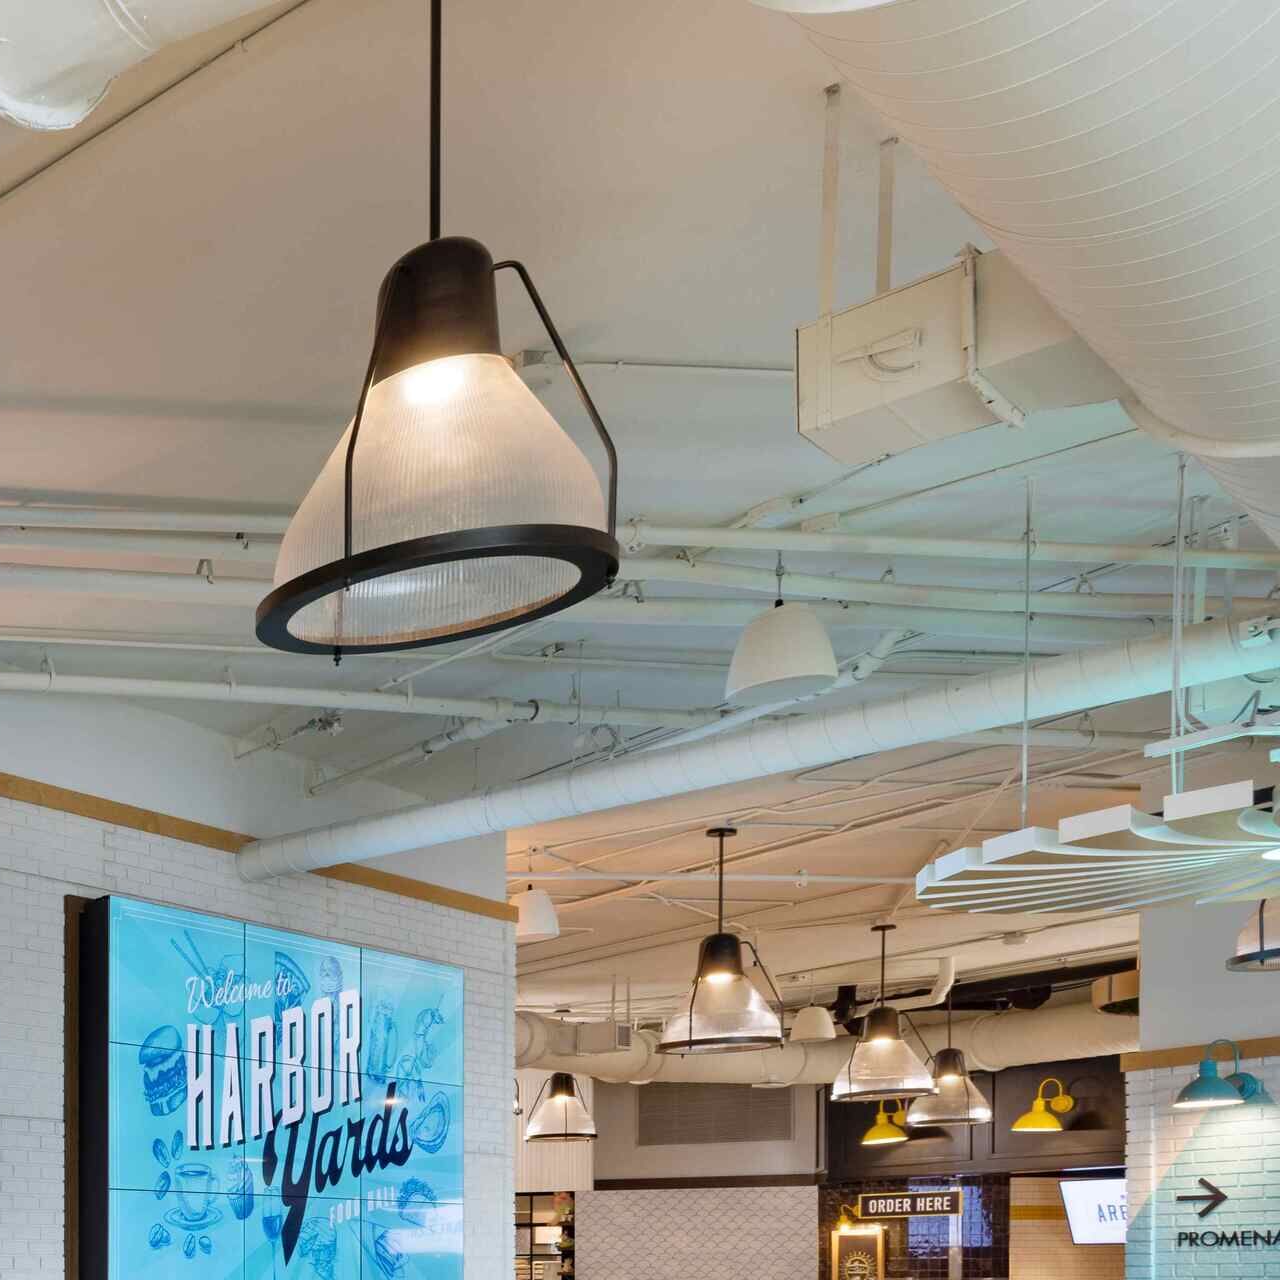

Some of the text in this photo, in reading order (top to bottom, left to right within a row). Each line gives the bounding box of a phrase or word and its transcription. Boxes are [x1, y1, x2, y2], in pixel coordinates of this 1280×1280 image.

[185, 970, 297, 1014] Welcome to
[186, 989, 362, 1150] HARBOR
[262, 1081, 414, 1266] Yards
[868, 1196, 951, 1213] ORDER HERE
